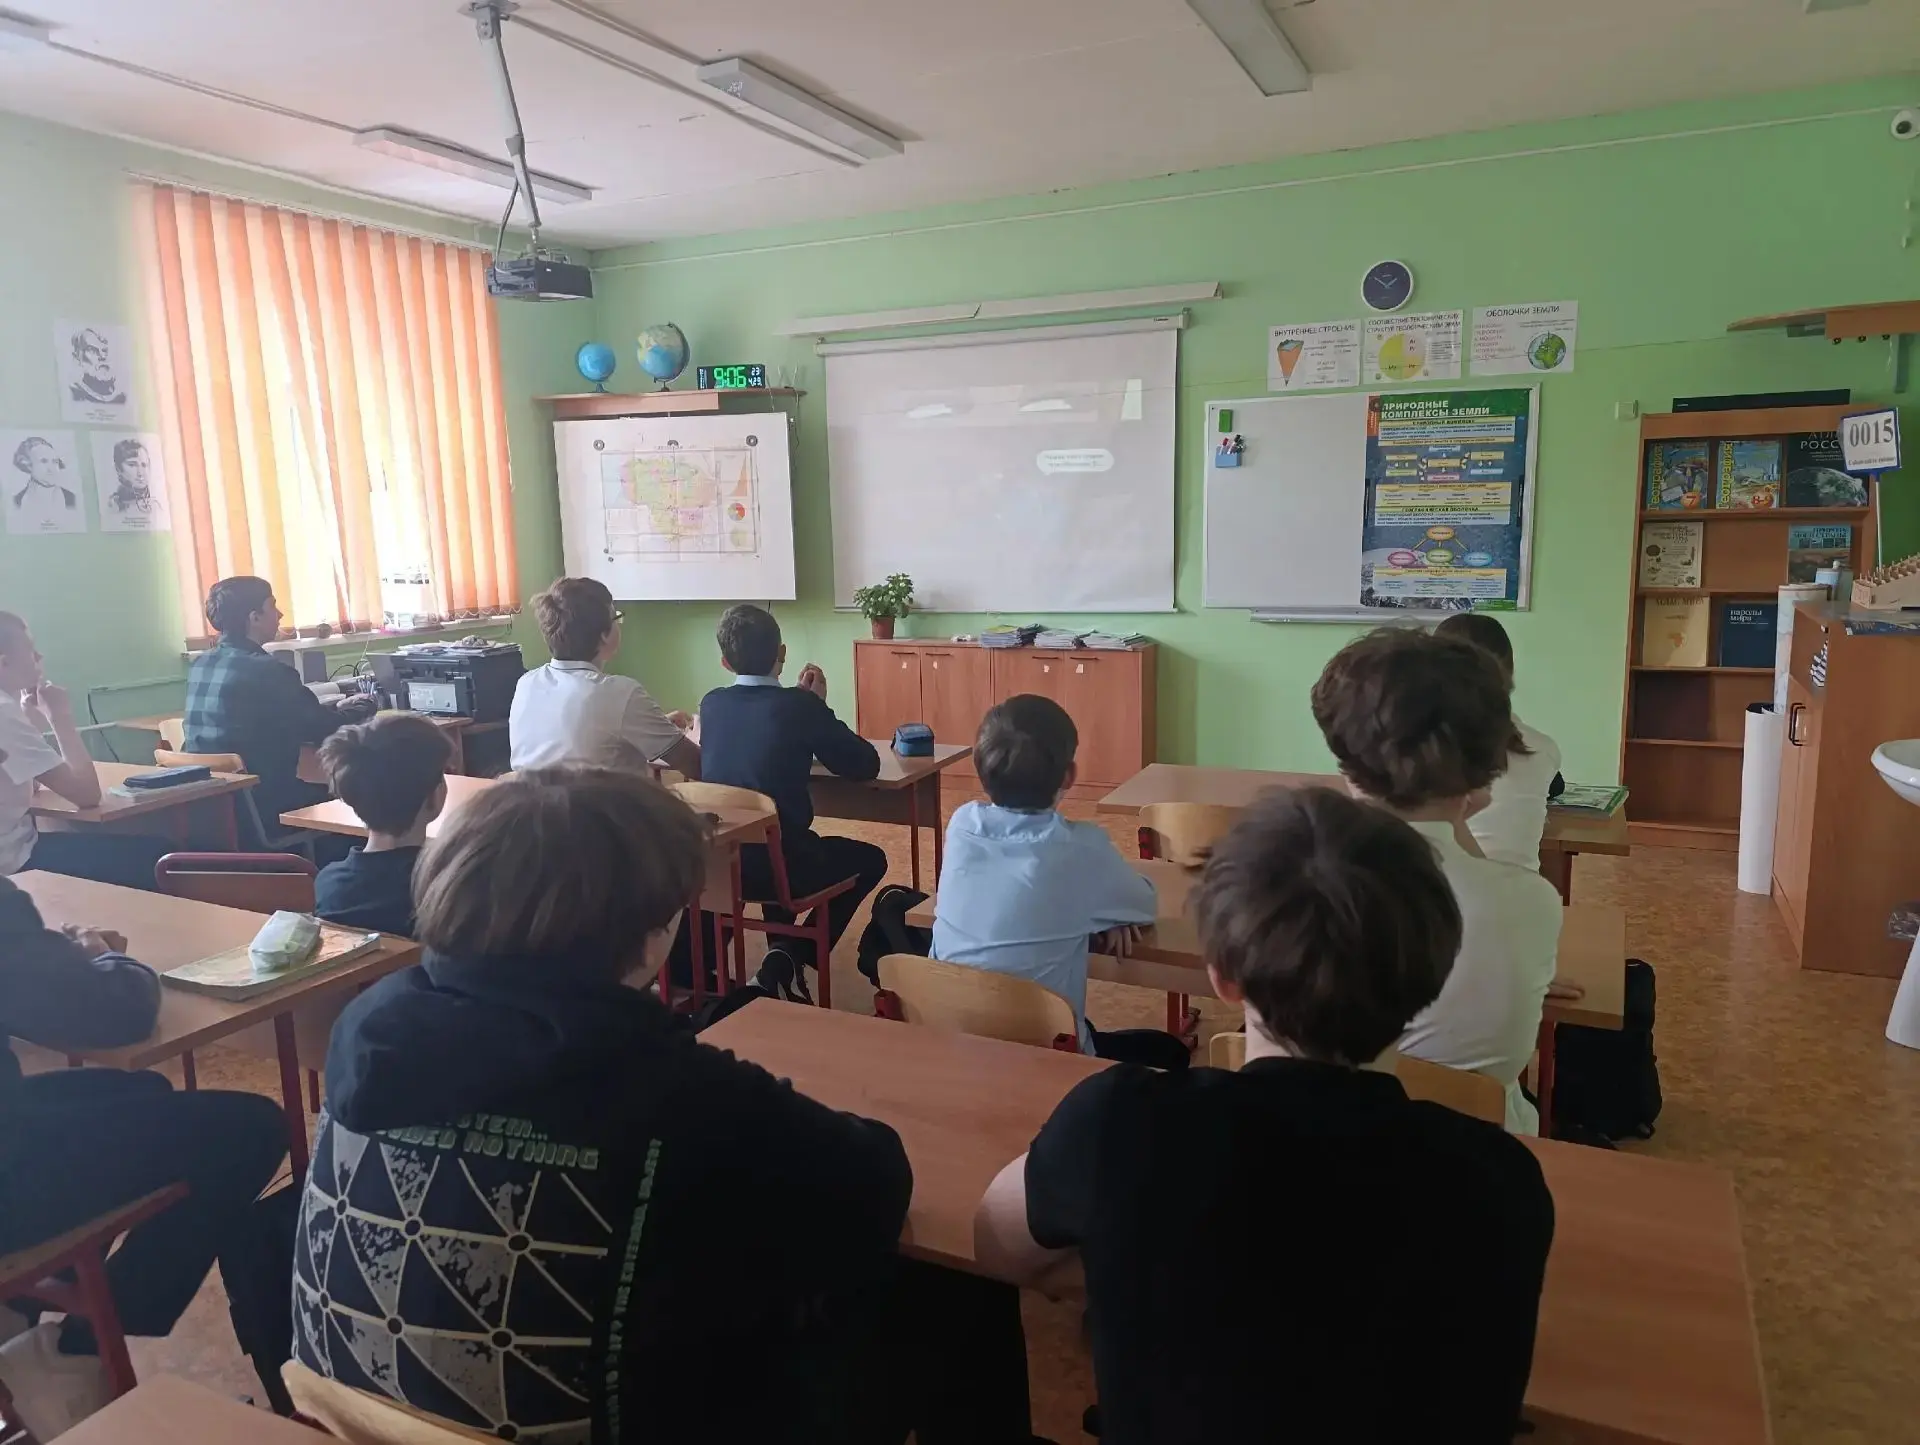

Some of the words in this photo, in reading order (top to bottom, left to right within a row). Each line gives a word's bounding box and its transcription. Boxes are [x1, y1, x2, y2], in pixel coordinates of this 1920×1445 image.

[1486, 307, 1530, 317] ОБОЛОЧКИ
[1532, 305, 1560, 314] ЗЕМЛИ
[1274, 327, 1317, 337] ВНУТРЕННЕЕ
[1382, 400, 1449, 411] ПРИРОДНЫЕ
[1381, 409, 1449, 419] КОМПЛЕКСЫ
[1452, 407, 1490, 416] ЗЕМЛИ
[1849, 418, 1894, 447] 0015
[1800, 439, 1839, 449] РОСС
[1686, 495, 1697, 507] 7
[463, 1130, 600, 1171] NOTHING
